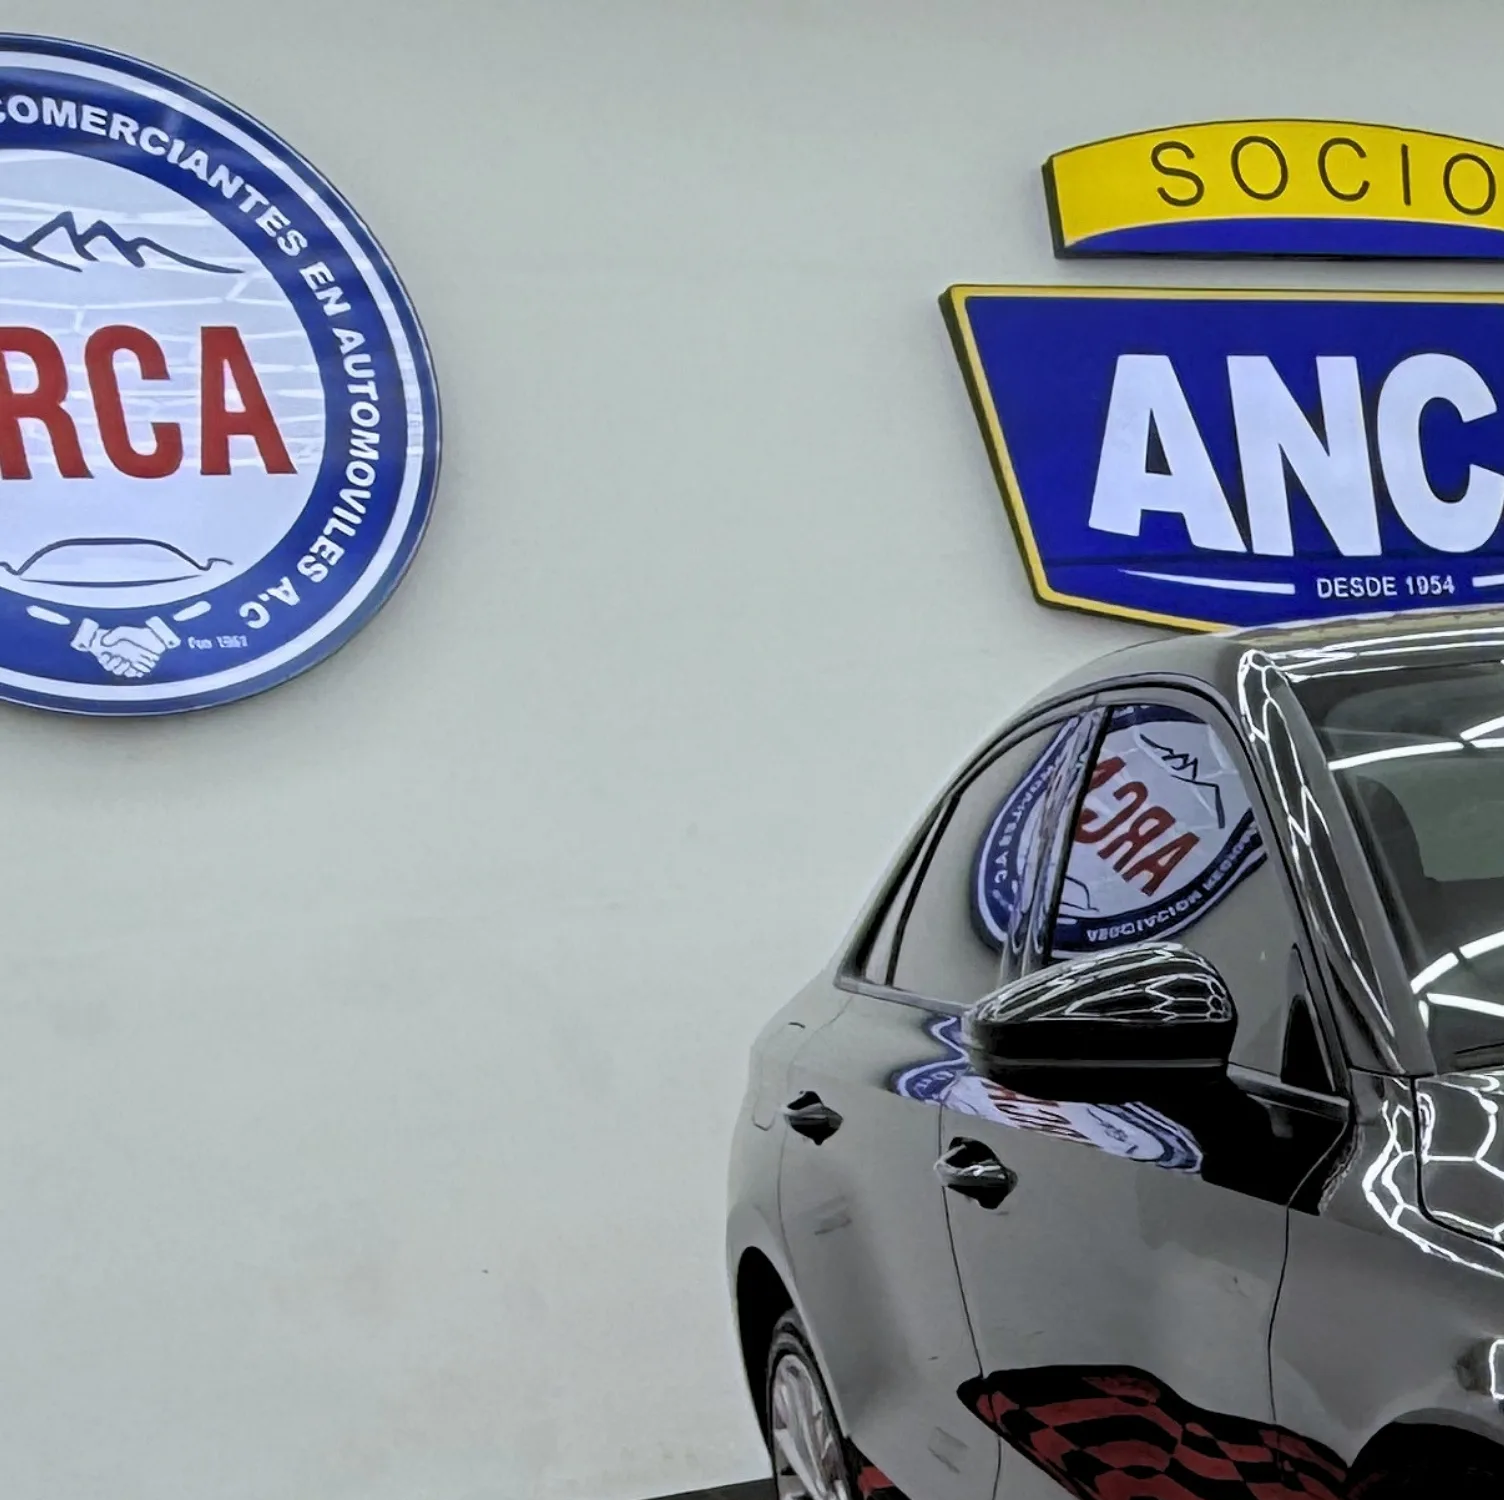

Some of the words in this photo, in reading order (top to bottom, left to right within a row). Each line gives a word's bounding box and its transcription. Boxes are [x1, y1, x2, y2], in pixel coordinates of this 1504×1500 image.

[0, 94, 308, 257] OMERCIANTES
[1150, 136, 1497, 216] SOCIO
[299, 262, 351, 317] EN
[297, 326, 380, 583] AUTOMOVILES
[1317, 576, 1398, 599] DESDE
